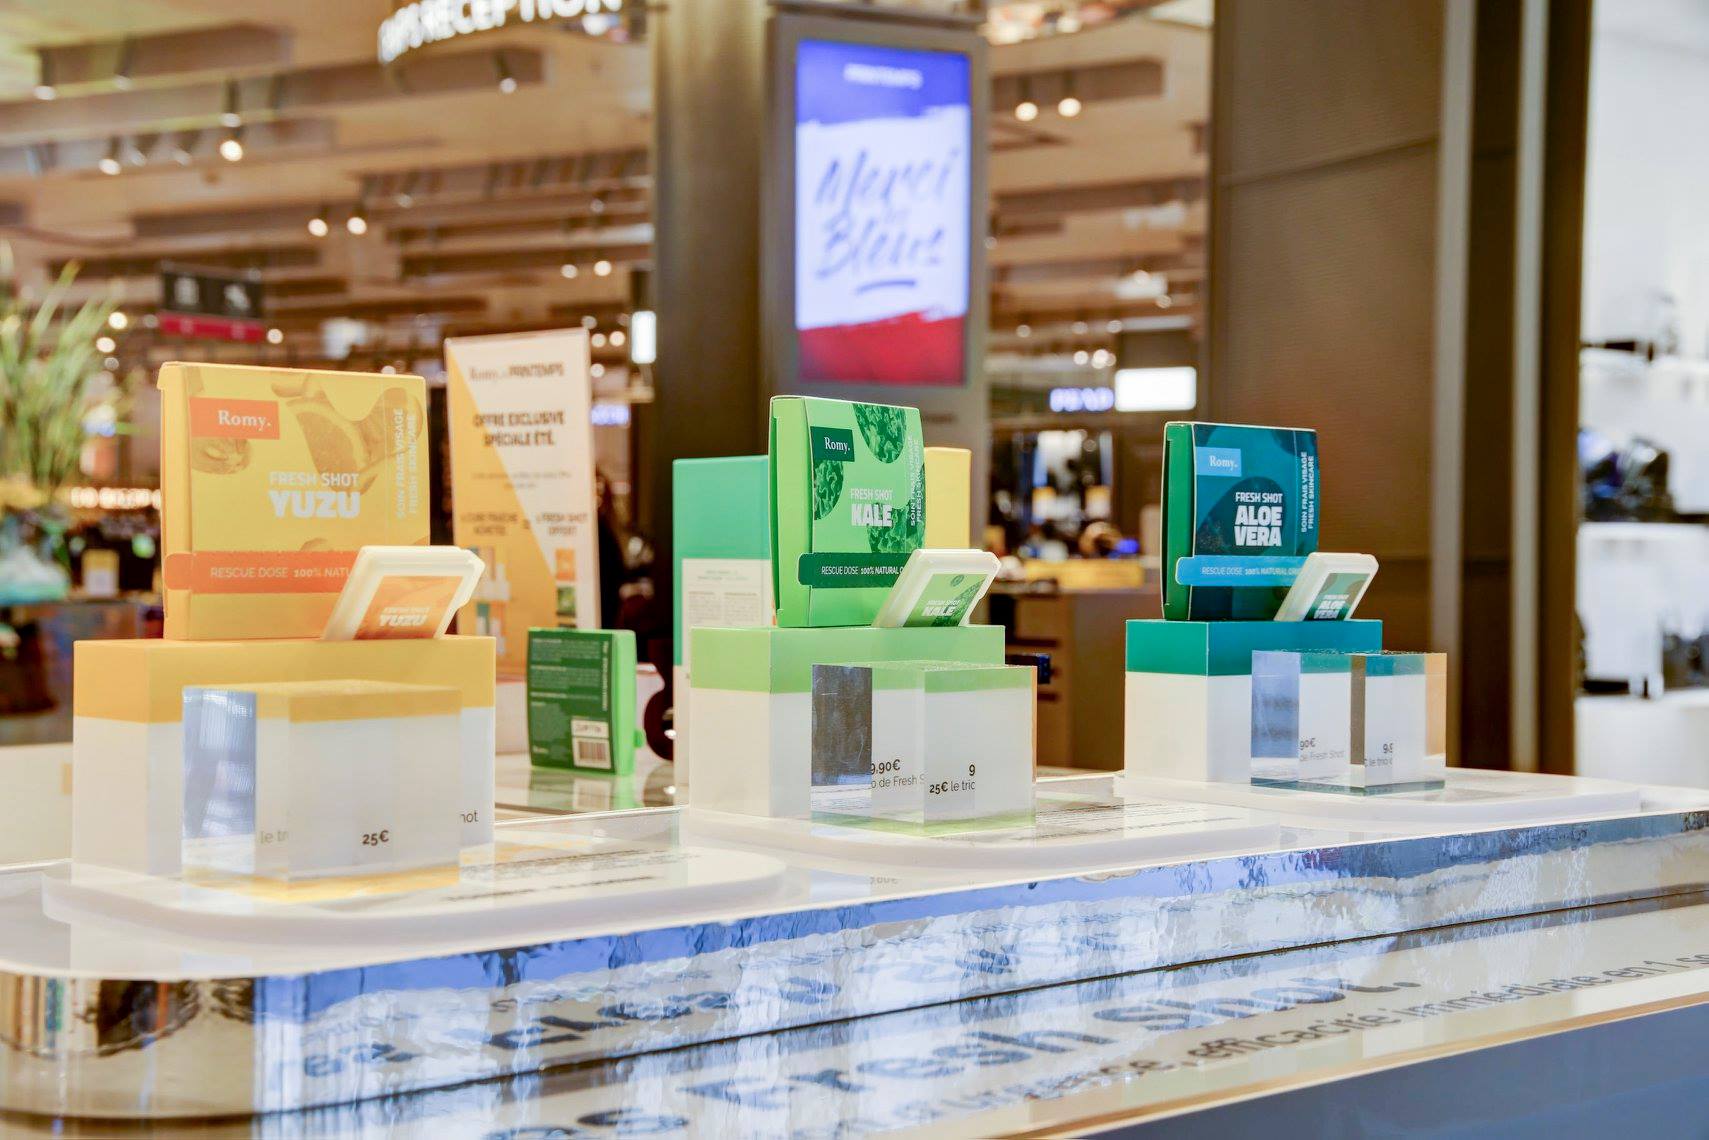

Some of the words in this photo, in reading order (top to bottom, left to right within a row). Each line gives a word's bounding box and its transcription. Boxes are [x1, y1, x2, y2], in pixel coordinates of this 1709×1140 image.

[218, 409, 272, 432] Romy.
[473, 412, 505, 428] OFFRE
[509, 411, 564, 426] EXCLUSIVE
[824, 436, 850, 455] Romy.
[1208, 455, 1239, 471] Romy.
[1300, 452, 1308, 484] VISAGE
[269, 471, 317, 486] FRESH
[321, 473, 360, 487] SHOT
[1307, 456, 1315, 500] SKINCARE
[850, 488, 873, 501] FRESH
[875, 489, 893, 501] SHOT
[1235, 491, 1260, 503] FRESH
[1262, 493, 1283, 503] SHOT
[268, 490, 361, 518] YUZU
[851, 504, 893, 527] KALE
[1235, 505, 1283, 526] ALOE
[1307, 500, 1315, 529] FRESH
[1234, 526, 1283, 547] VERA
[210, 567, 256, 579] RESCUE
[258, 567, 289, 579] DOSE
[294, 567, 321, 578] 100%
[821, 566, 843, 575] RESCUE
[844, 566, 859, 575] DOSE
[861, 567, 875, 575] 100%
[875, 566, 899, 575] NATURAL
[1202, 566, 1226, 575] RESCUE
[1226, 566, 1242, 575] DOSE
[1260, 567, 1287, 575] NATURAL
[921, 606, 957, 617] KALE
[379, 614, 428, 627] YUZU
[879, 778, 890, 788] de
[893, 774, 918, 786] Fresh
[930, 781, 948, 795] 25€
[951, 780, 960, 791] le
[362, 830, 389, 846] 25€
